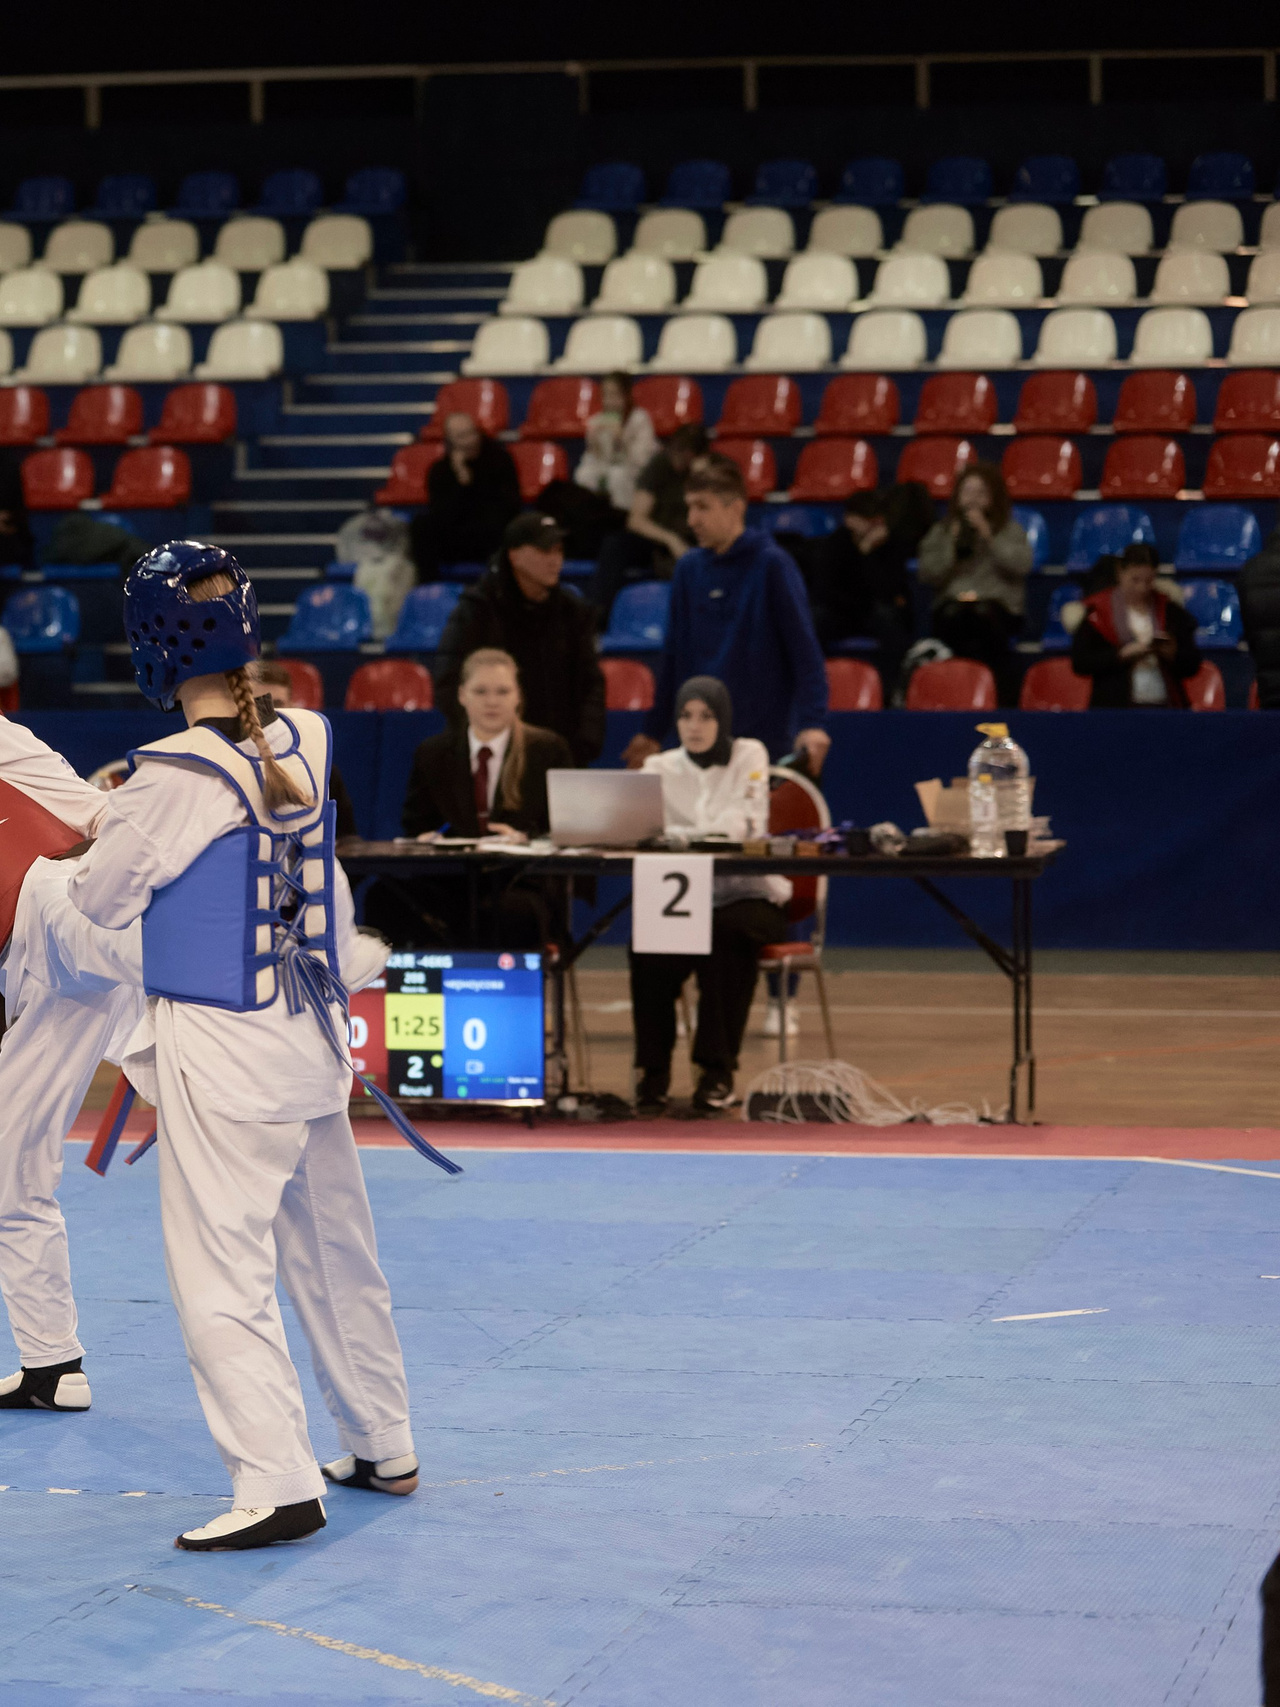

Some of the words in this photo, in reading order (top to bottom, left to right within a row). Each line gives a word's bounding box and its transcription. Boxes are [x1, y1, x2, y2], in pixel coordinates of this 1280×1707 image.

[662, 871, 690, 917] 2
[346, 1016, 368, 1048] 0
[391, 1016, 440, 1036] 1:25
[462, 1018, 487, 1050] 0
[407, 1056, 424, 1079] 2
[398, 1083, 433, 1097] Round
